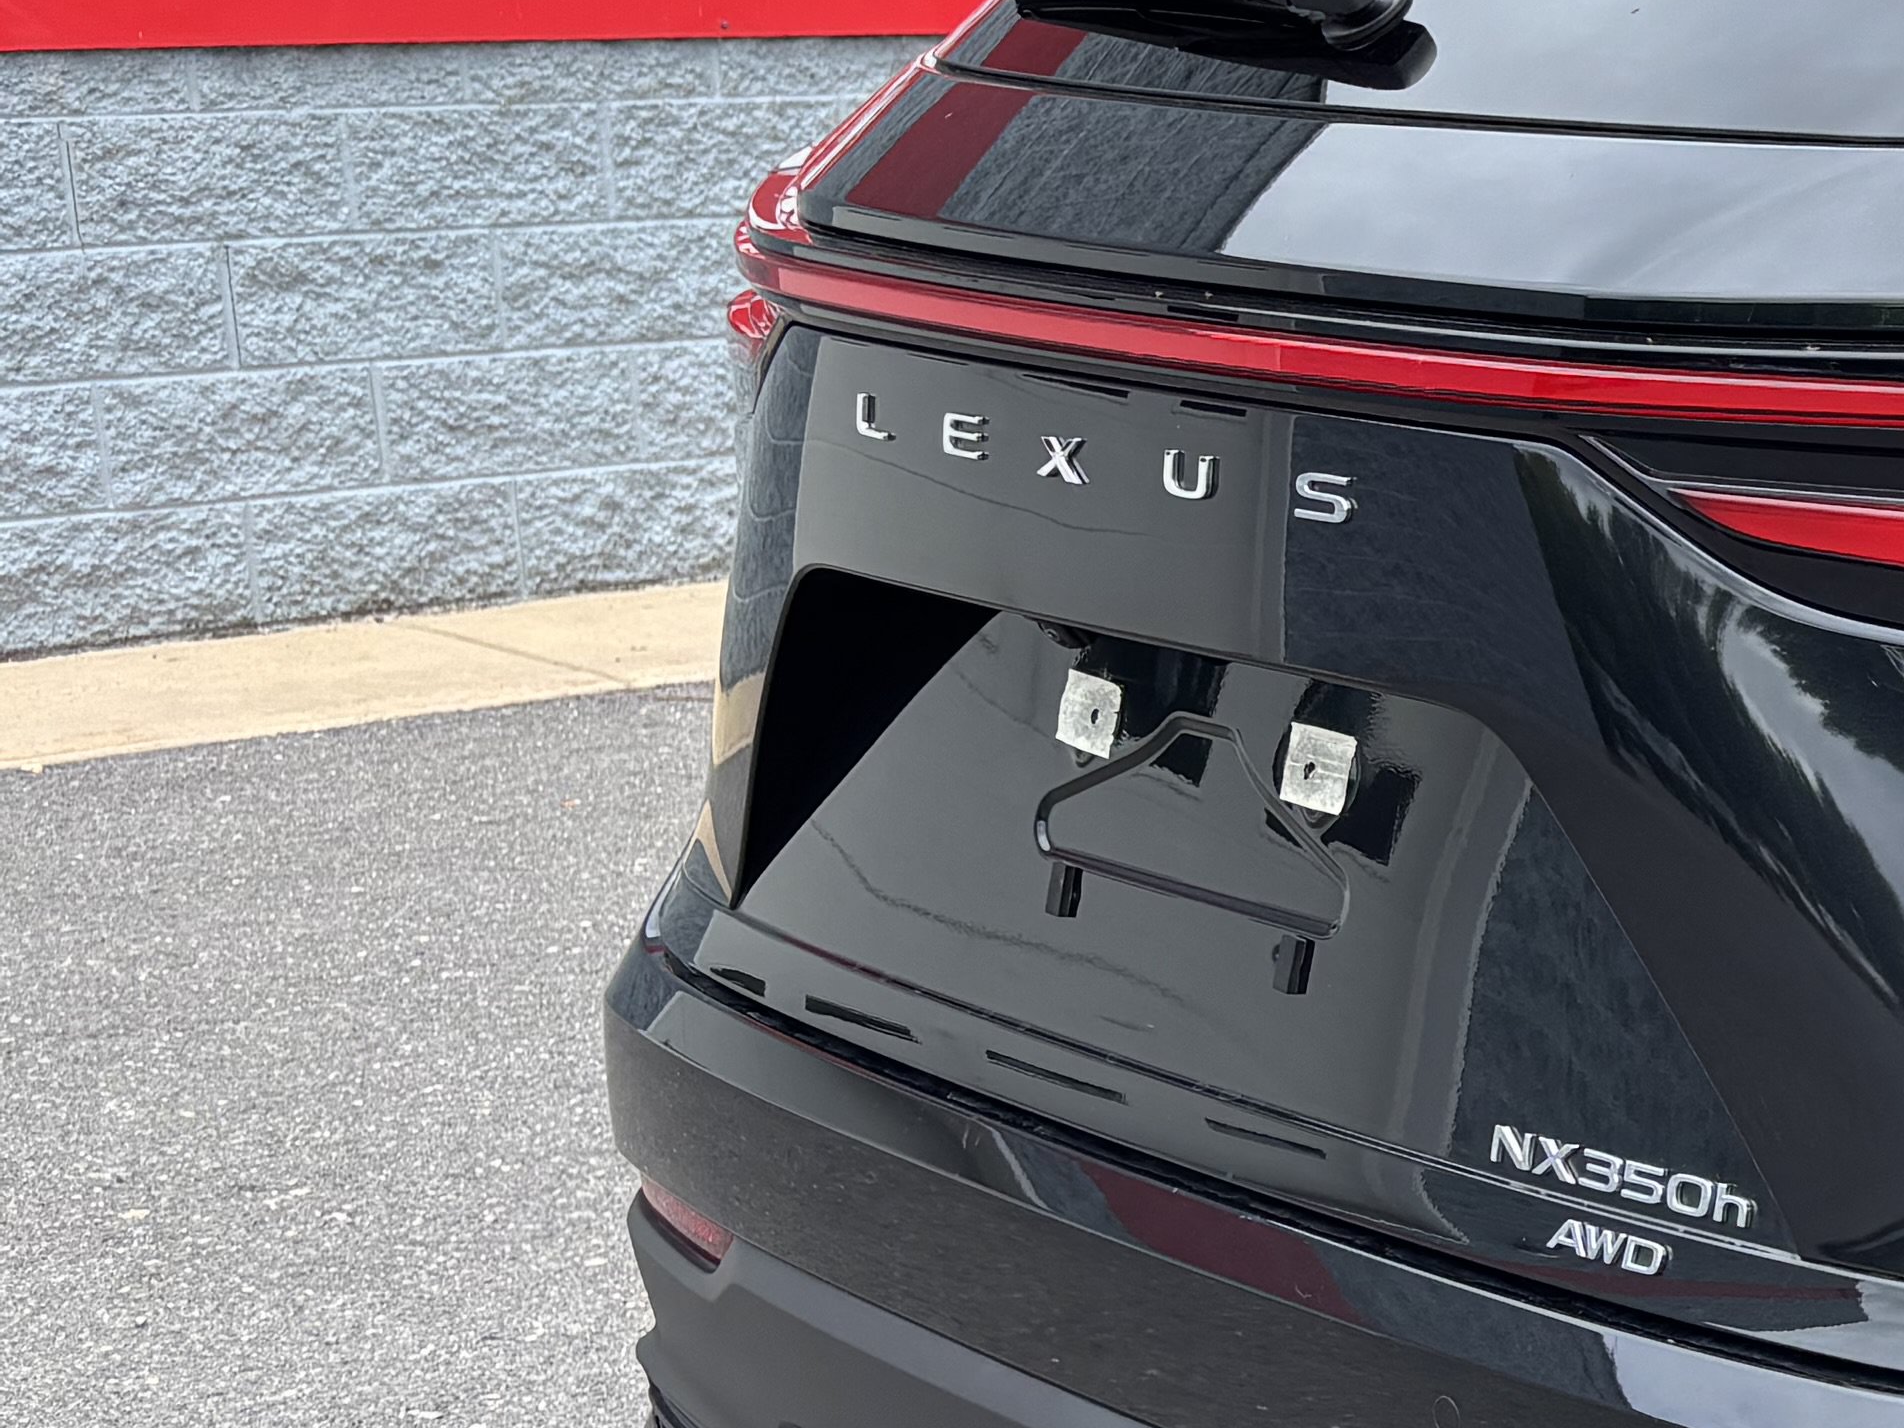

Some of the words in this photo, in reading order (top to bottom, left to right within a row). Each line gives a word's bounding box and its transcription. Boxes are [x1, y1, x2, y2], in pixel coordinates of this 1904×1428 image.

[855, 391, 1359, 525] LEXUS
[1489, 1124, 1758, 1229] NX350h
[1546, 1218, 1673, 1276] AWD
